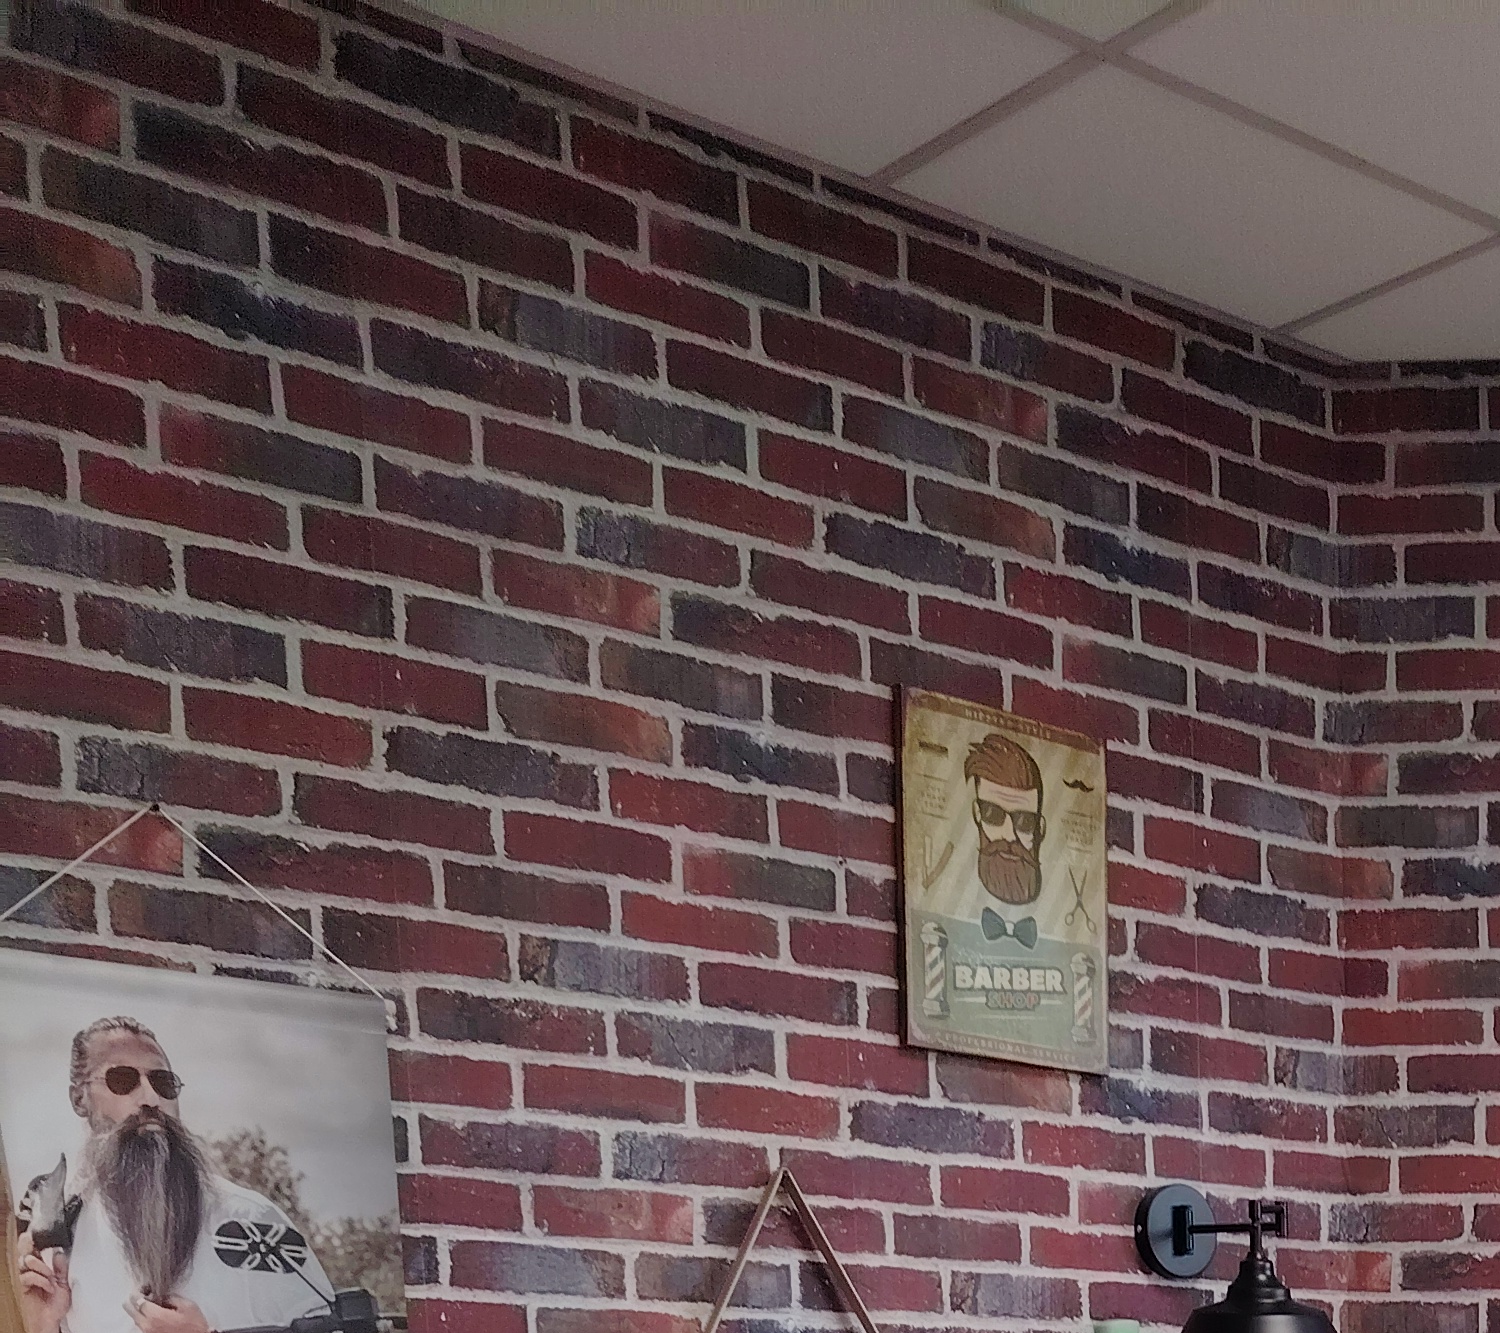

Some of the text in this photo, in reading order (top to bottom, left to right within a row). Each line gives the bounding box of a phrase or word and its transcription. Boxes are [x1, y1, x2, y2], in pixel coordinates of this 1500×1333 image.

[954, 964, 1066, 993] BARBER
[988, 990, 1039, 1010] SHOP
[945, 1034, 1027, 1053] PROFESSIONAL
[1033, 1048, 1076, 1062] SERVICE
